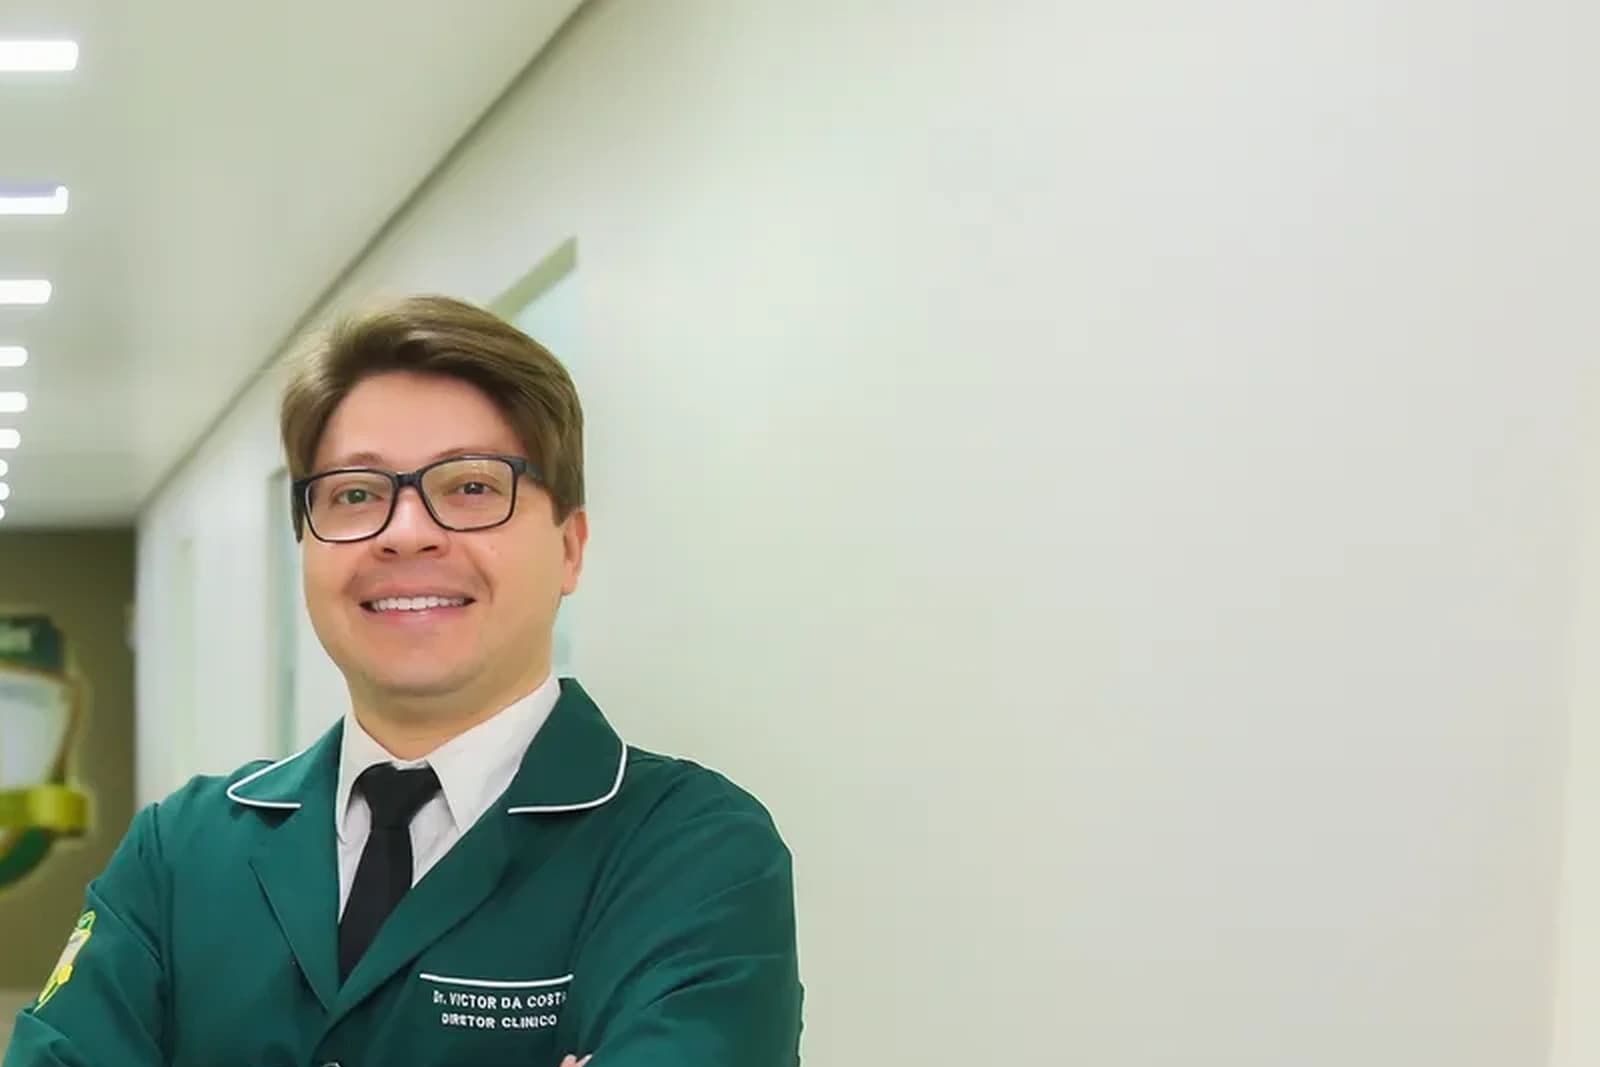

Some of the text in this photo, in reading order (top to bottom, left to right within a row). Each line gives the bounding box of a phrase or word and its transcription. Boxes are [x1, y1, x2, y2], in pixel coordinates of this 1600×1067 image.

[449, 992, 497, 1009] VICTOR
[501, 996, 523, 1009] DA
[441, 1012, 557, 1029] DIRETOR CLINICO
